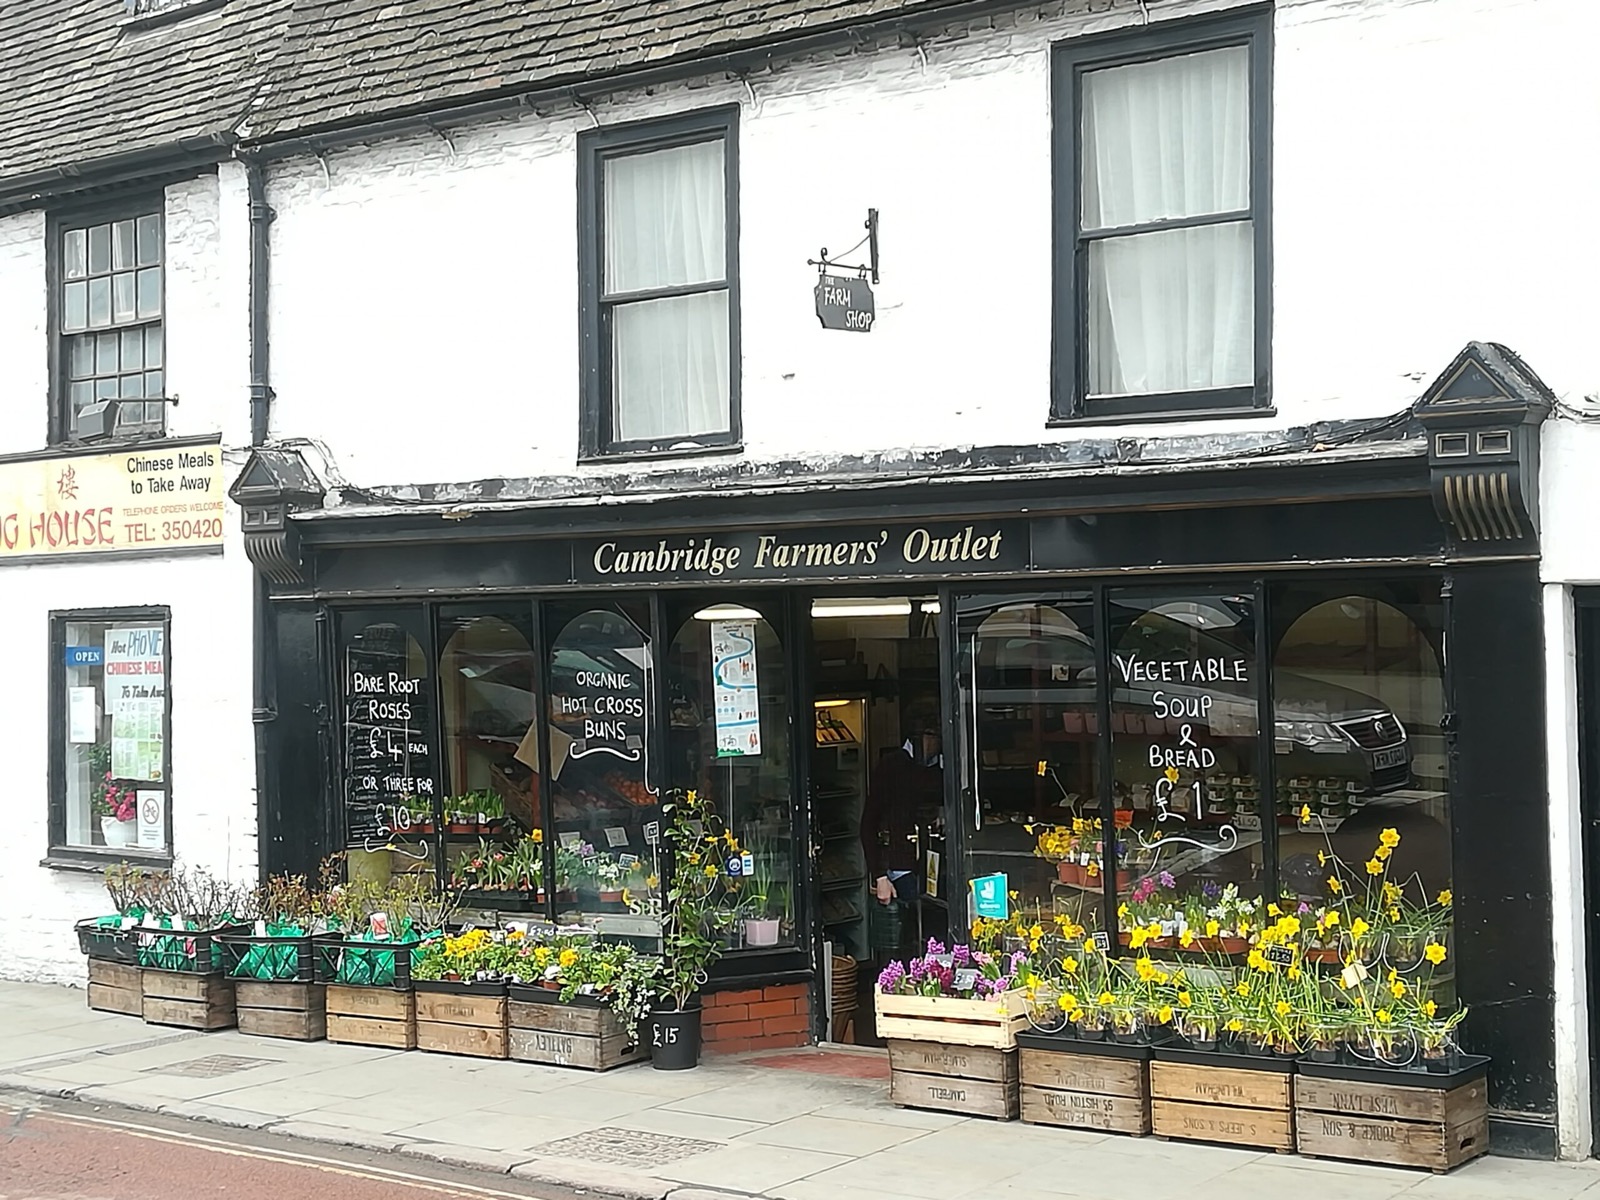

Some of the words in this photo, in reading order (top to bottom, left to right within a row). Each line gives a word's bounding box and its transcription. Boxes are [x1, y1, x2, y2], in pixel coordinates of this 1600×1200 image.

[824, 287, 851, 308] FARM
[845, 310, 872, 330] SHOP
[127, 456, 174, 474] Chinese
[178, 451, 214, 469] Meals
[131, 480, 143, 494] to
[147, 476, 174, 493] Take
[179, 475, 211, 492] Away
[123, 506, 159, 517] TELEPHONE
[160, 503, 187, 515] ORDERS
[189, 501, 223, 512] WELCOME
[0, 513, 19, 550] G
[29, 507, 115, 548] HOUSE
[124, 522, 156, 543] TEL:
[162, 518, 222, 541] 350420
[593, 538, 741, 576] Cambridge
[903, 526, 1002, 563] Outlet
[75, 651, 101, 662] OPEN
[106, 661, 143, 675] CHINESE
[144, 661, 164, 674] MEA
[1116, 653, 1248, 682] VEGETABLE
[354, 672, 386, 693] BARE
[388, 672, 420, 695] ROOT
[576, 671, 631, 690] ORGANIC
[121, 685, 131, 699] To
[369, 699, 412, 720] ROSES
[562, 696, 588, 714] HOT
[594, 696, 644, 717] CROSS
[1153, 691, 1213, 718] SOUP
[585, 719, 627, 741] BUNS
[1179, 724, 1198, 748] &
[408, 743, 429, 755] EACH
[1150, 744, 1215, 768] BREAD
[363, 776, 379, 791] OR
[383, 775, 414, 792] THREE
[417, 778, 434, 795] FOR
[652, 1023, 680, 1048] £15
[1070, 1095, 1099, 1110] HISTON
[1368, 1095, 1398, 1114] WEST
[1182, 1116, 1205, 1130] SONS
[1321, 1118, 1342, 1137] SON
